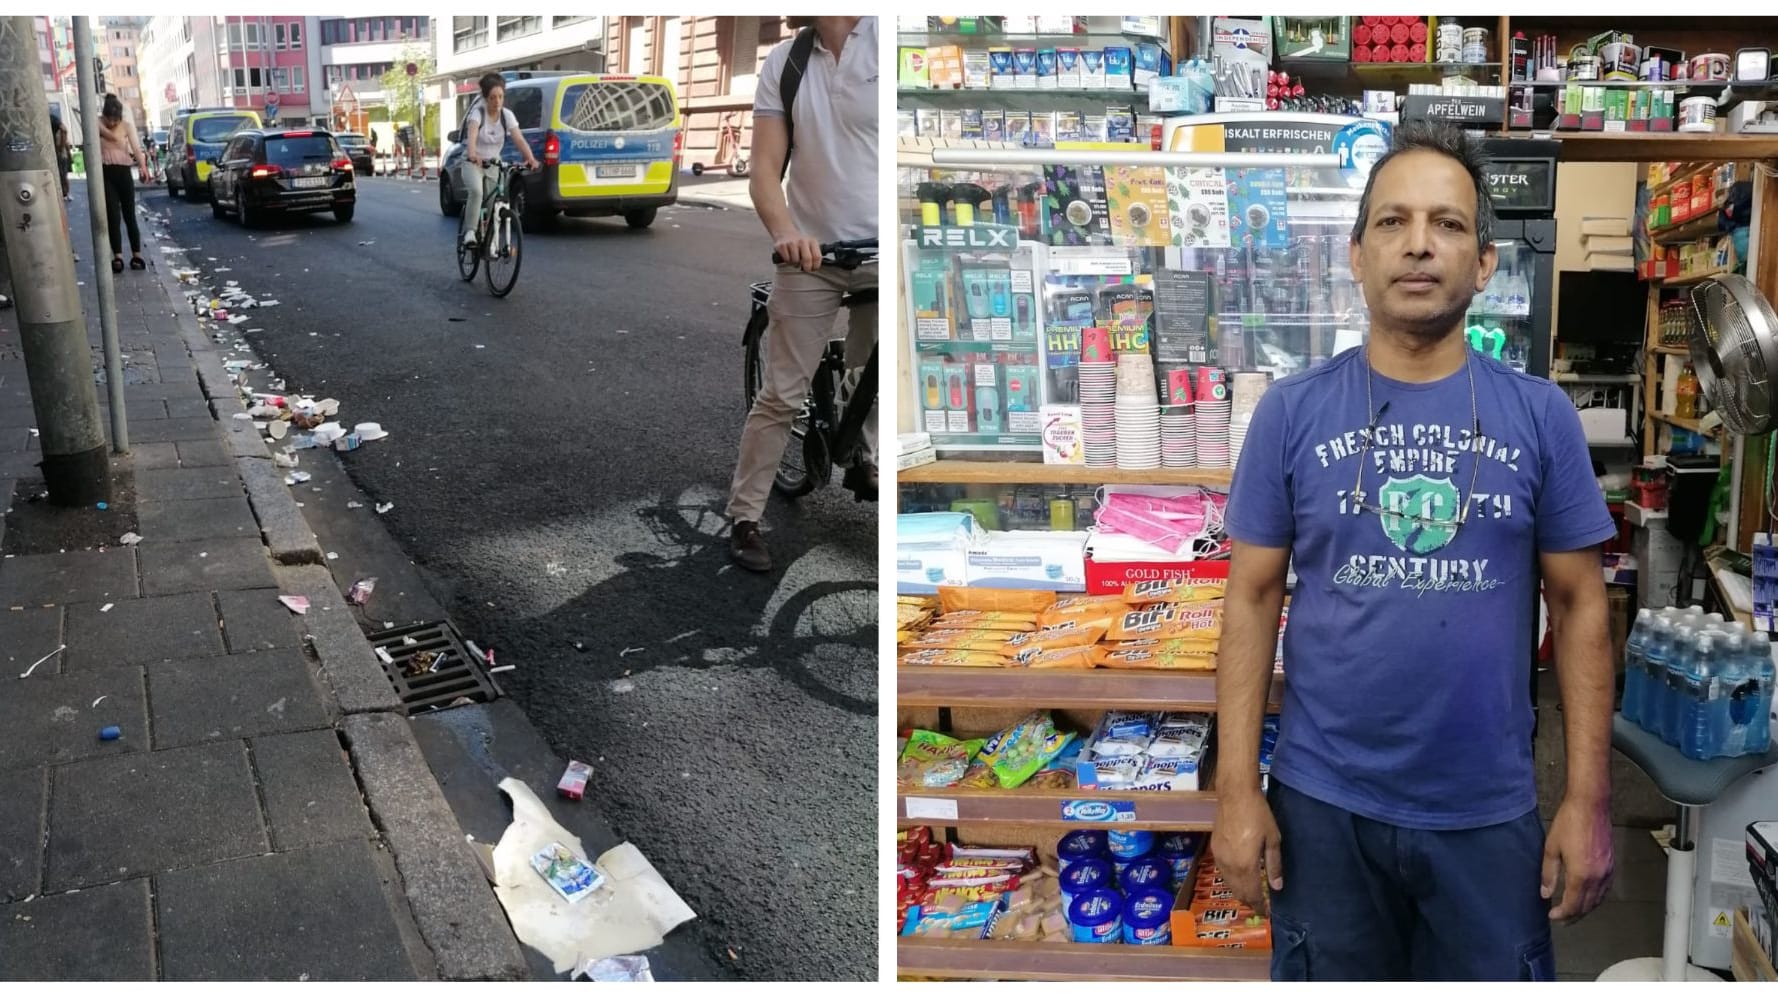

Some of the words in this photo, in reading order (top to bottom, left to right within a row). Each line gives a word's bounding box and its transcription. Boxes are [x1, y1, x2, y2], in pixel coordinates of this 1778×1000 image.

[1427, 104, 1486, 117] APFELWEIN
[1263, 129, 1331, 141] ERFRISCHEN
[570, 140, 608, 149] POLIZEI
[923, 228, 1010, 247] RELX
[1046, 325, 1083, 333] PREMIU
[1108, 325, 1145, 333] REMIUM
[1048, 333, 1079, 351] HH
[1315, 424, 1405, 468] FRENCH
[1413, 424, 1521, 471] COLONIAL
[1374, 449, 1460, 474] EMPIRE
[1125, 569, 1160, 579] GOLD
[1163, 569, 1191, 579] FISH
[1350, 555, 1489, 583] CENTURY
[1333, 564, 1395, 588] Global
[1180, 608, 1213, 621] Roll
[1190, 619, 1213, 630] Hot
[1094, 757, 1138, 768] noppers
